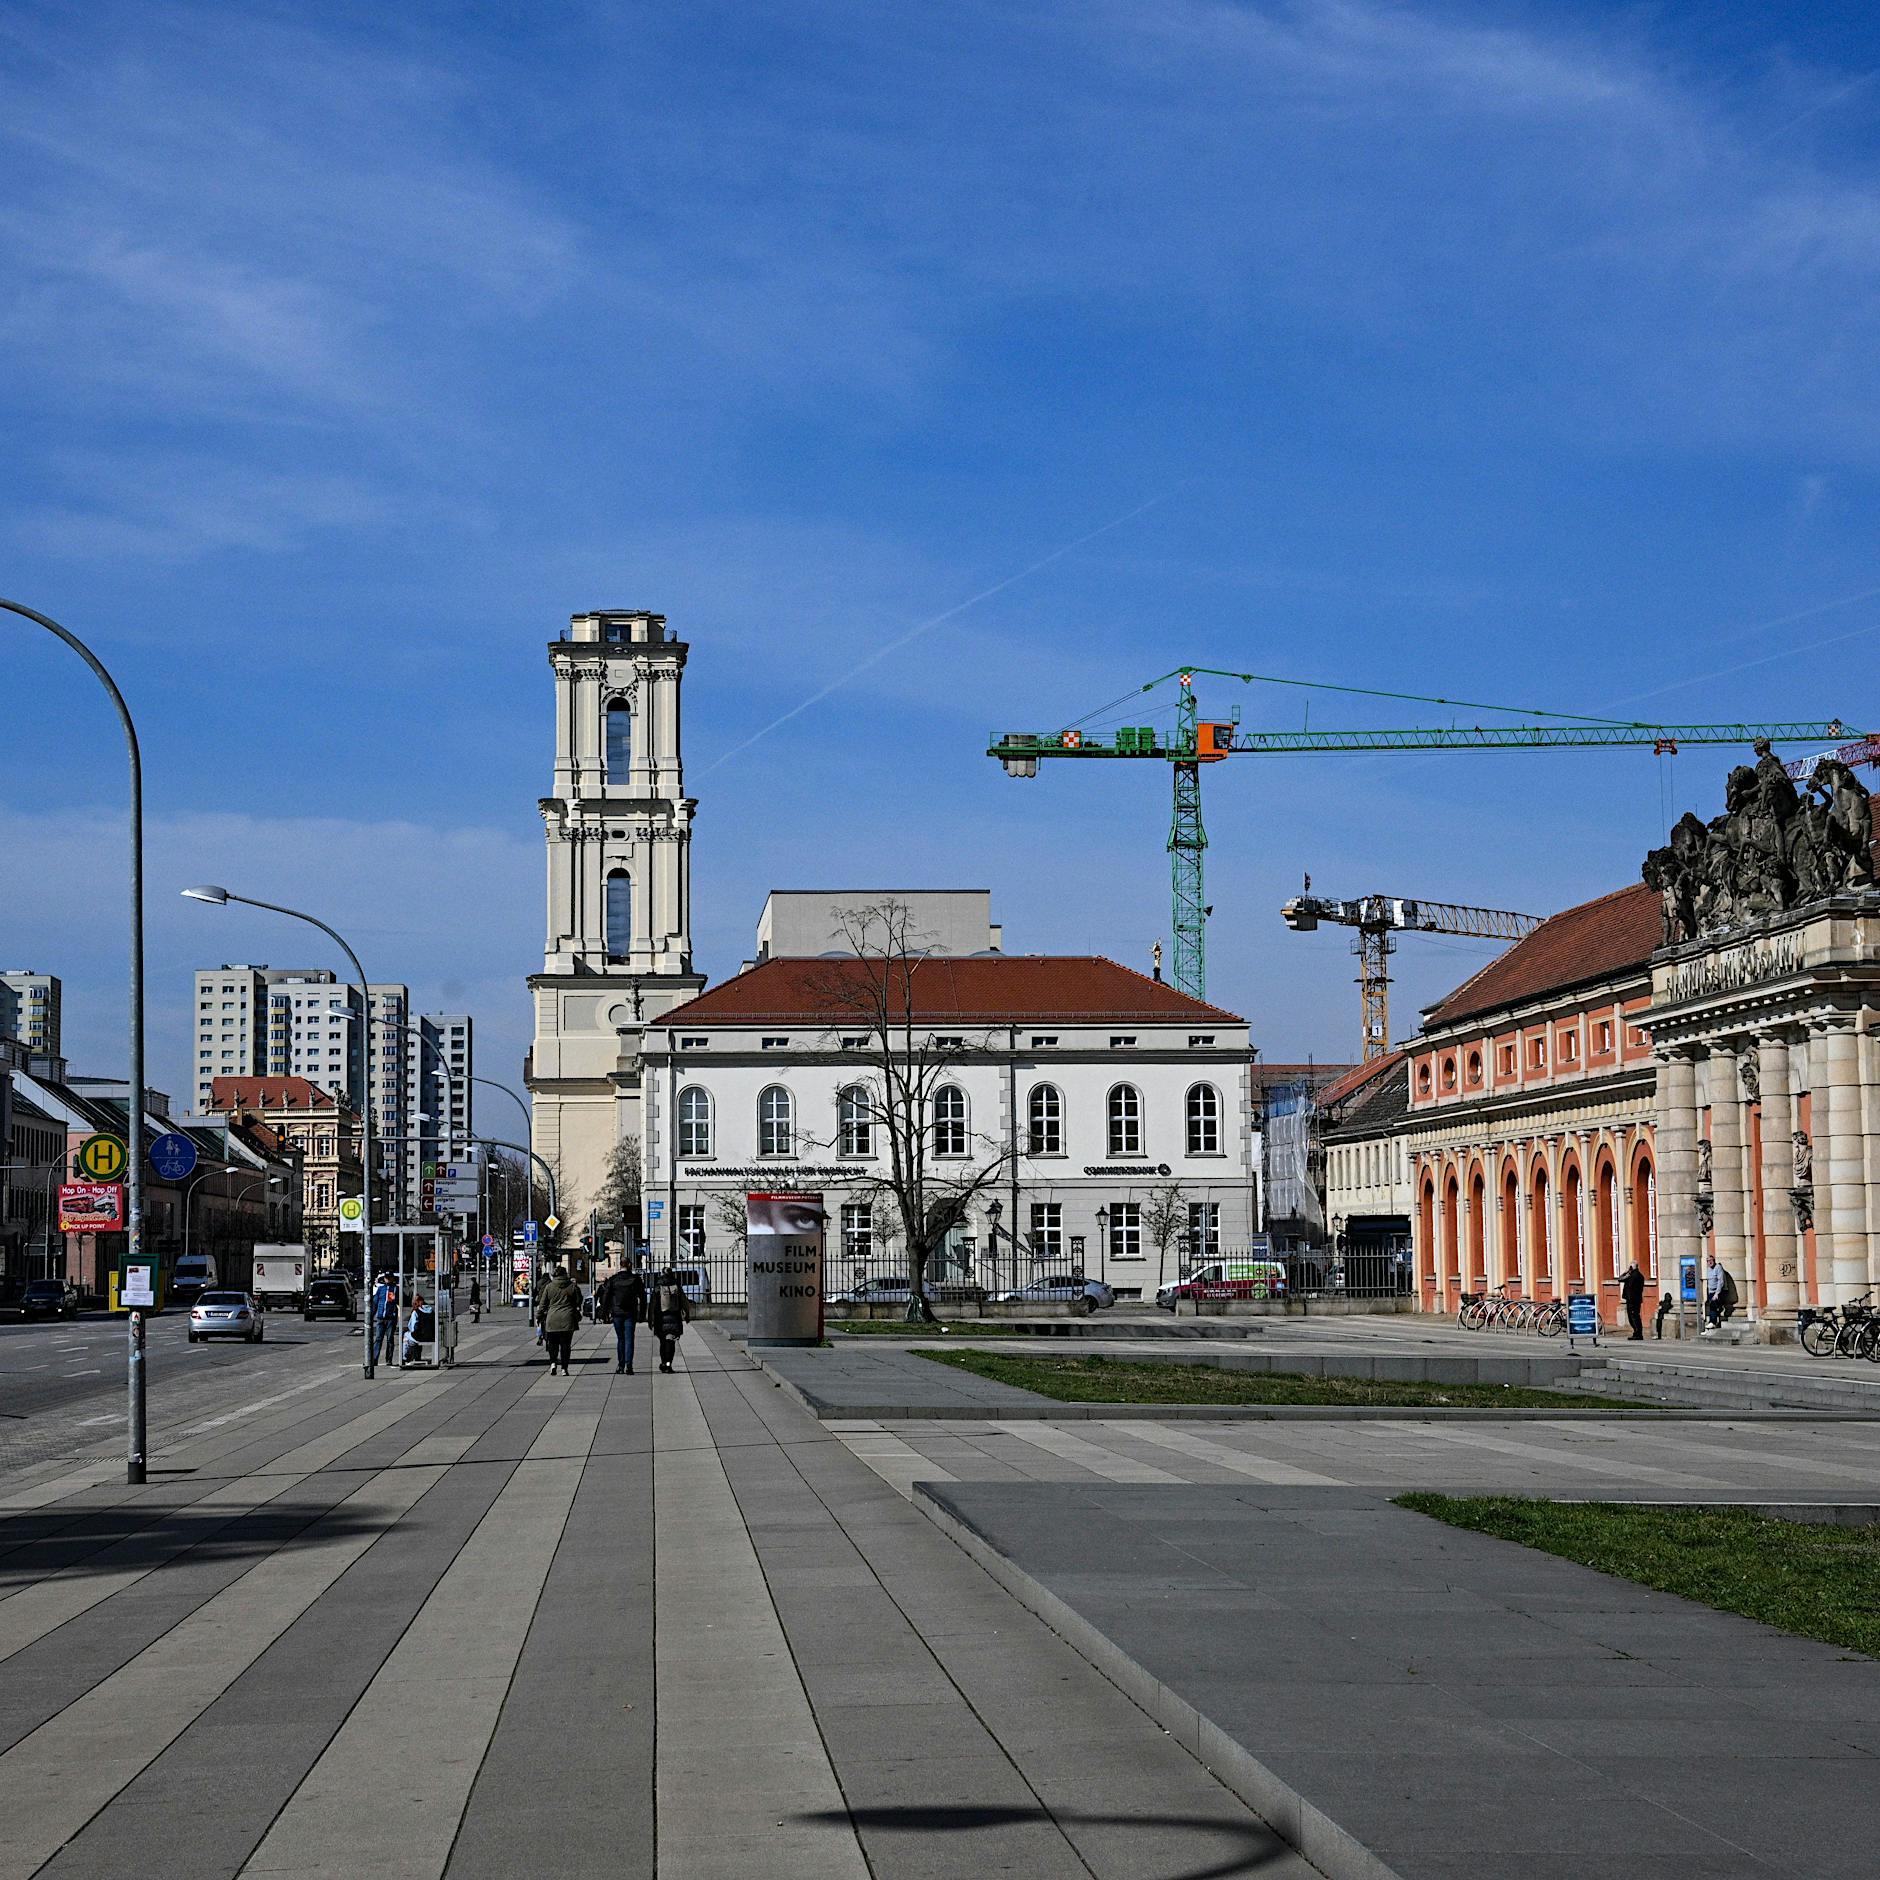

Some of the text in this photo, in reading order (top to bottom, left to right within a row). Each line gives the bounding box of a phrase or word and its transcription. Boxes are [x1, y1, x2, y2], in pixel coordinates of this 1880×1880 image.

[94, 1144, 112, 1170] H
[62, 1187, 75, 1195] Hop
[77, 1186, 86, 1194] On
[92, 1186, 105, 1195] Hop
[347, 1204, 356, 1216] H
[785, 1246, 817, 1257] FILM
[753, 1262, 816, 1274] MUSEUM
[779, 1286, 816, 1298] KINO
